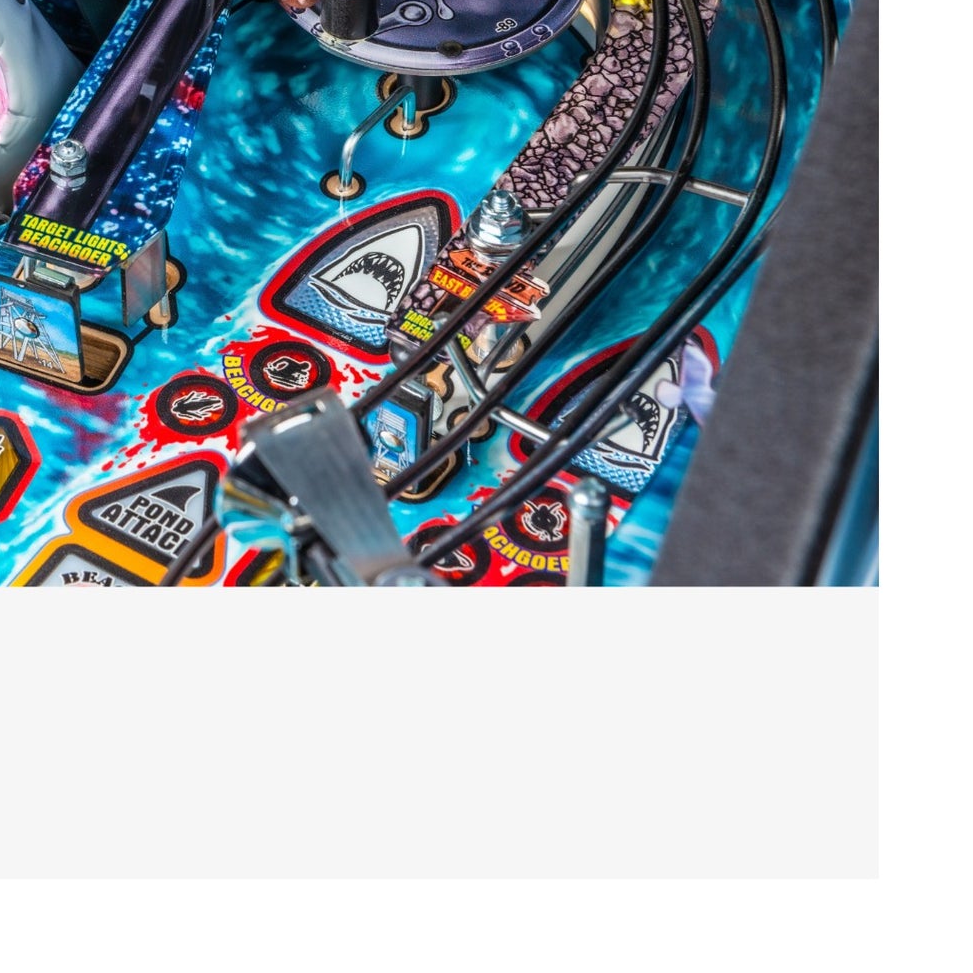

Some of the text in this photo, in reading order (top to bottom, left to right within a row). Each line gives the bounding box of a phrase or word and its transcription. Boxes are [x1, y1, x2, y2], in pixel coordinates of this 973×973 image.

[20, 213, 74, 240] TARGET
[18, 230, 112, 267] BEACHGOER
[432, 270, 461, 295] EAST
[128, 494, 195, 534] POND
